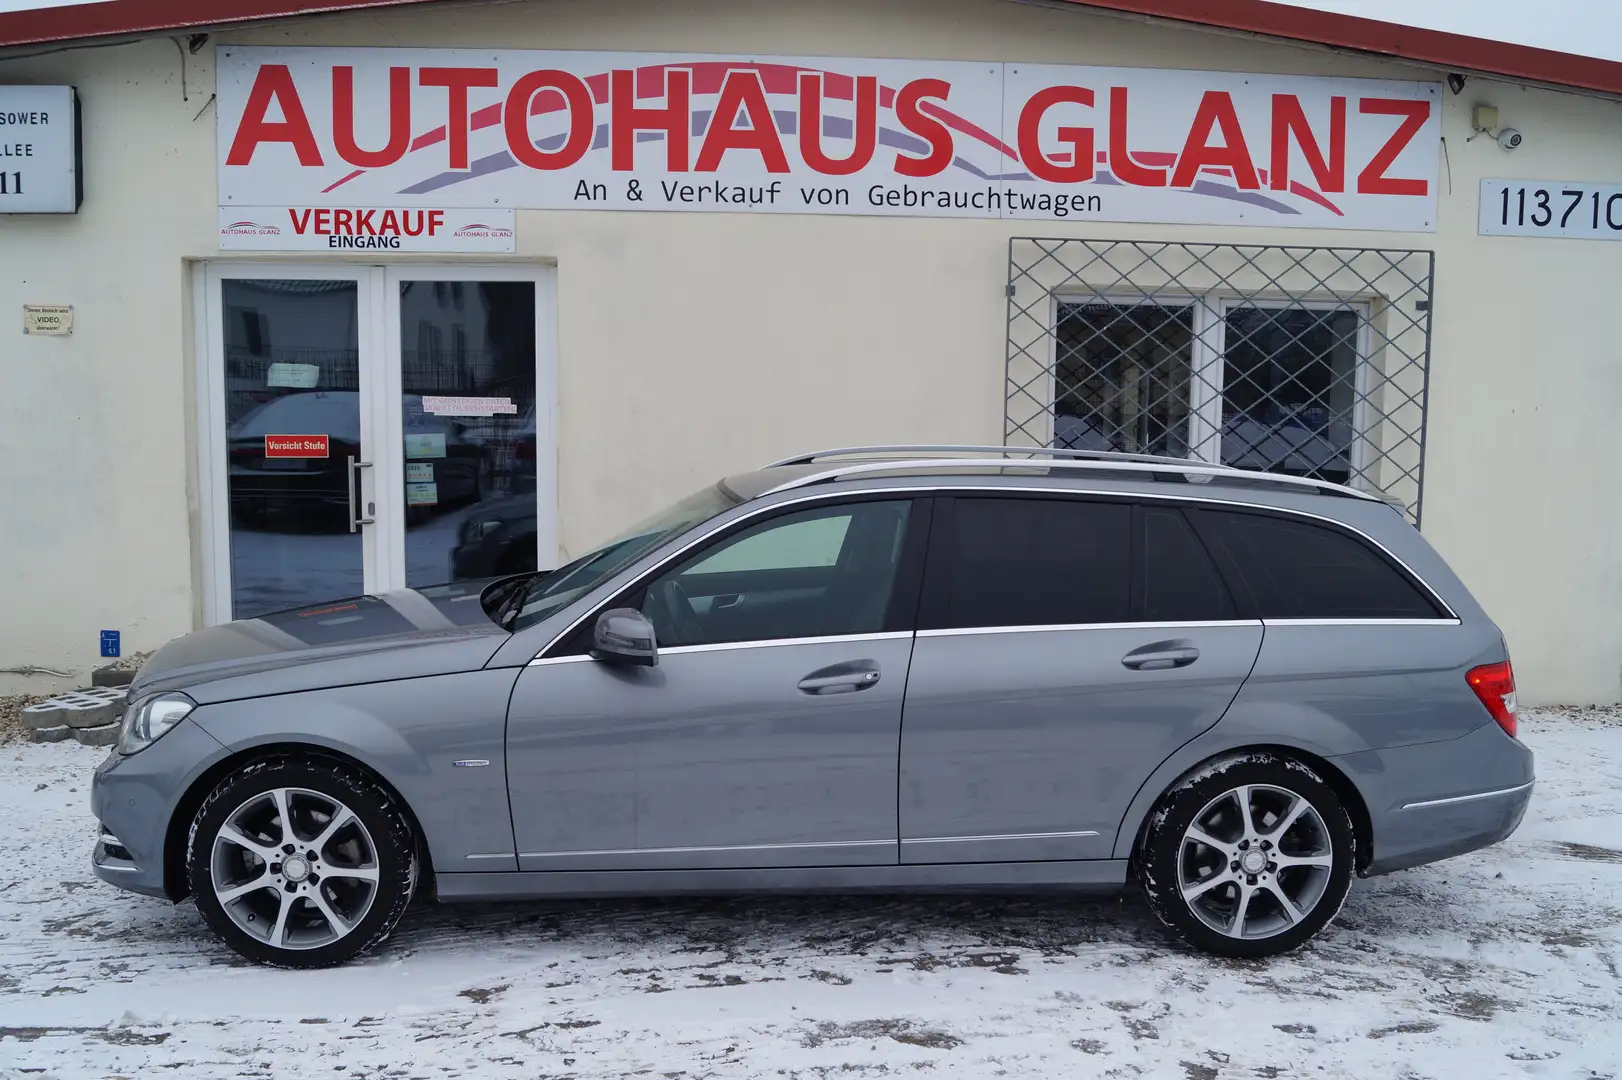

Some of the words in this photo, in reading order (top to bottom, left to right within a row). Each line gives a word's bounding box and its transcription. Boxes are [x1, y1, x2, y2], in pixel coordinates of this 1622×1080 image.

[226, 64, 954, 178] AUTOHAUS
[1016, 85, 1432, 197] GLANZ
[574, 179, 607, 201] An
[626, 179, 644, 202] &
[661, 180, 782, 204] Verkauf
[800, 187, 849, 205] von
[868, 184, 1102, 217] Gebrauchtwagen
[288, 208, 445, 236] VERKAUF
[328, 235, 400, 249] EINGANG
[268, 441, 303, 450] Vorsicht
[304, 441, 326, 450] Stufe
